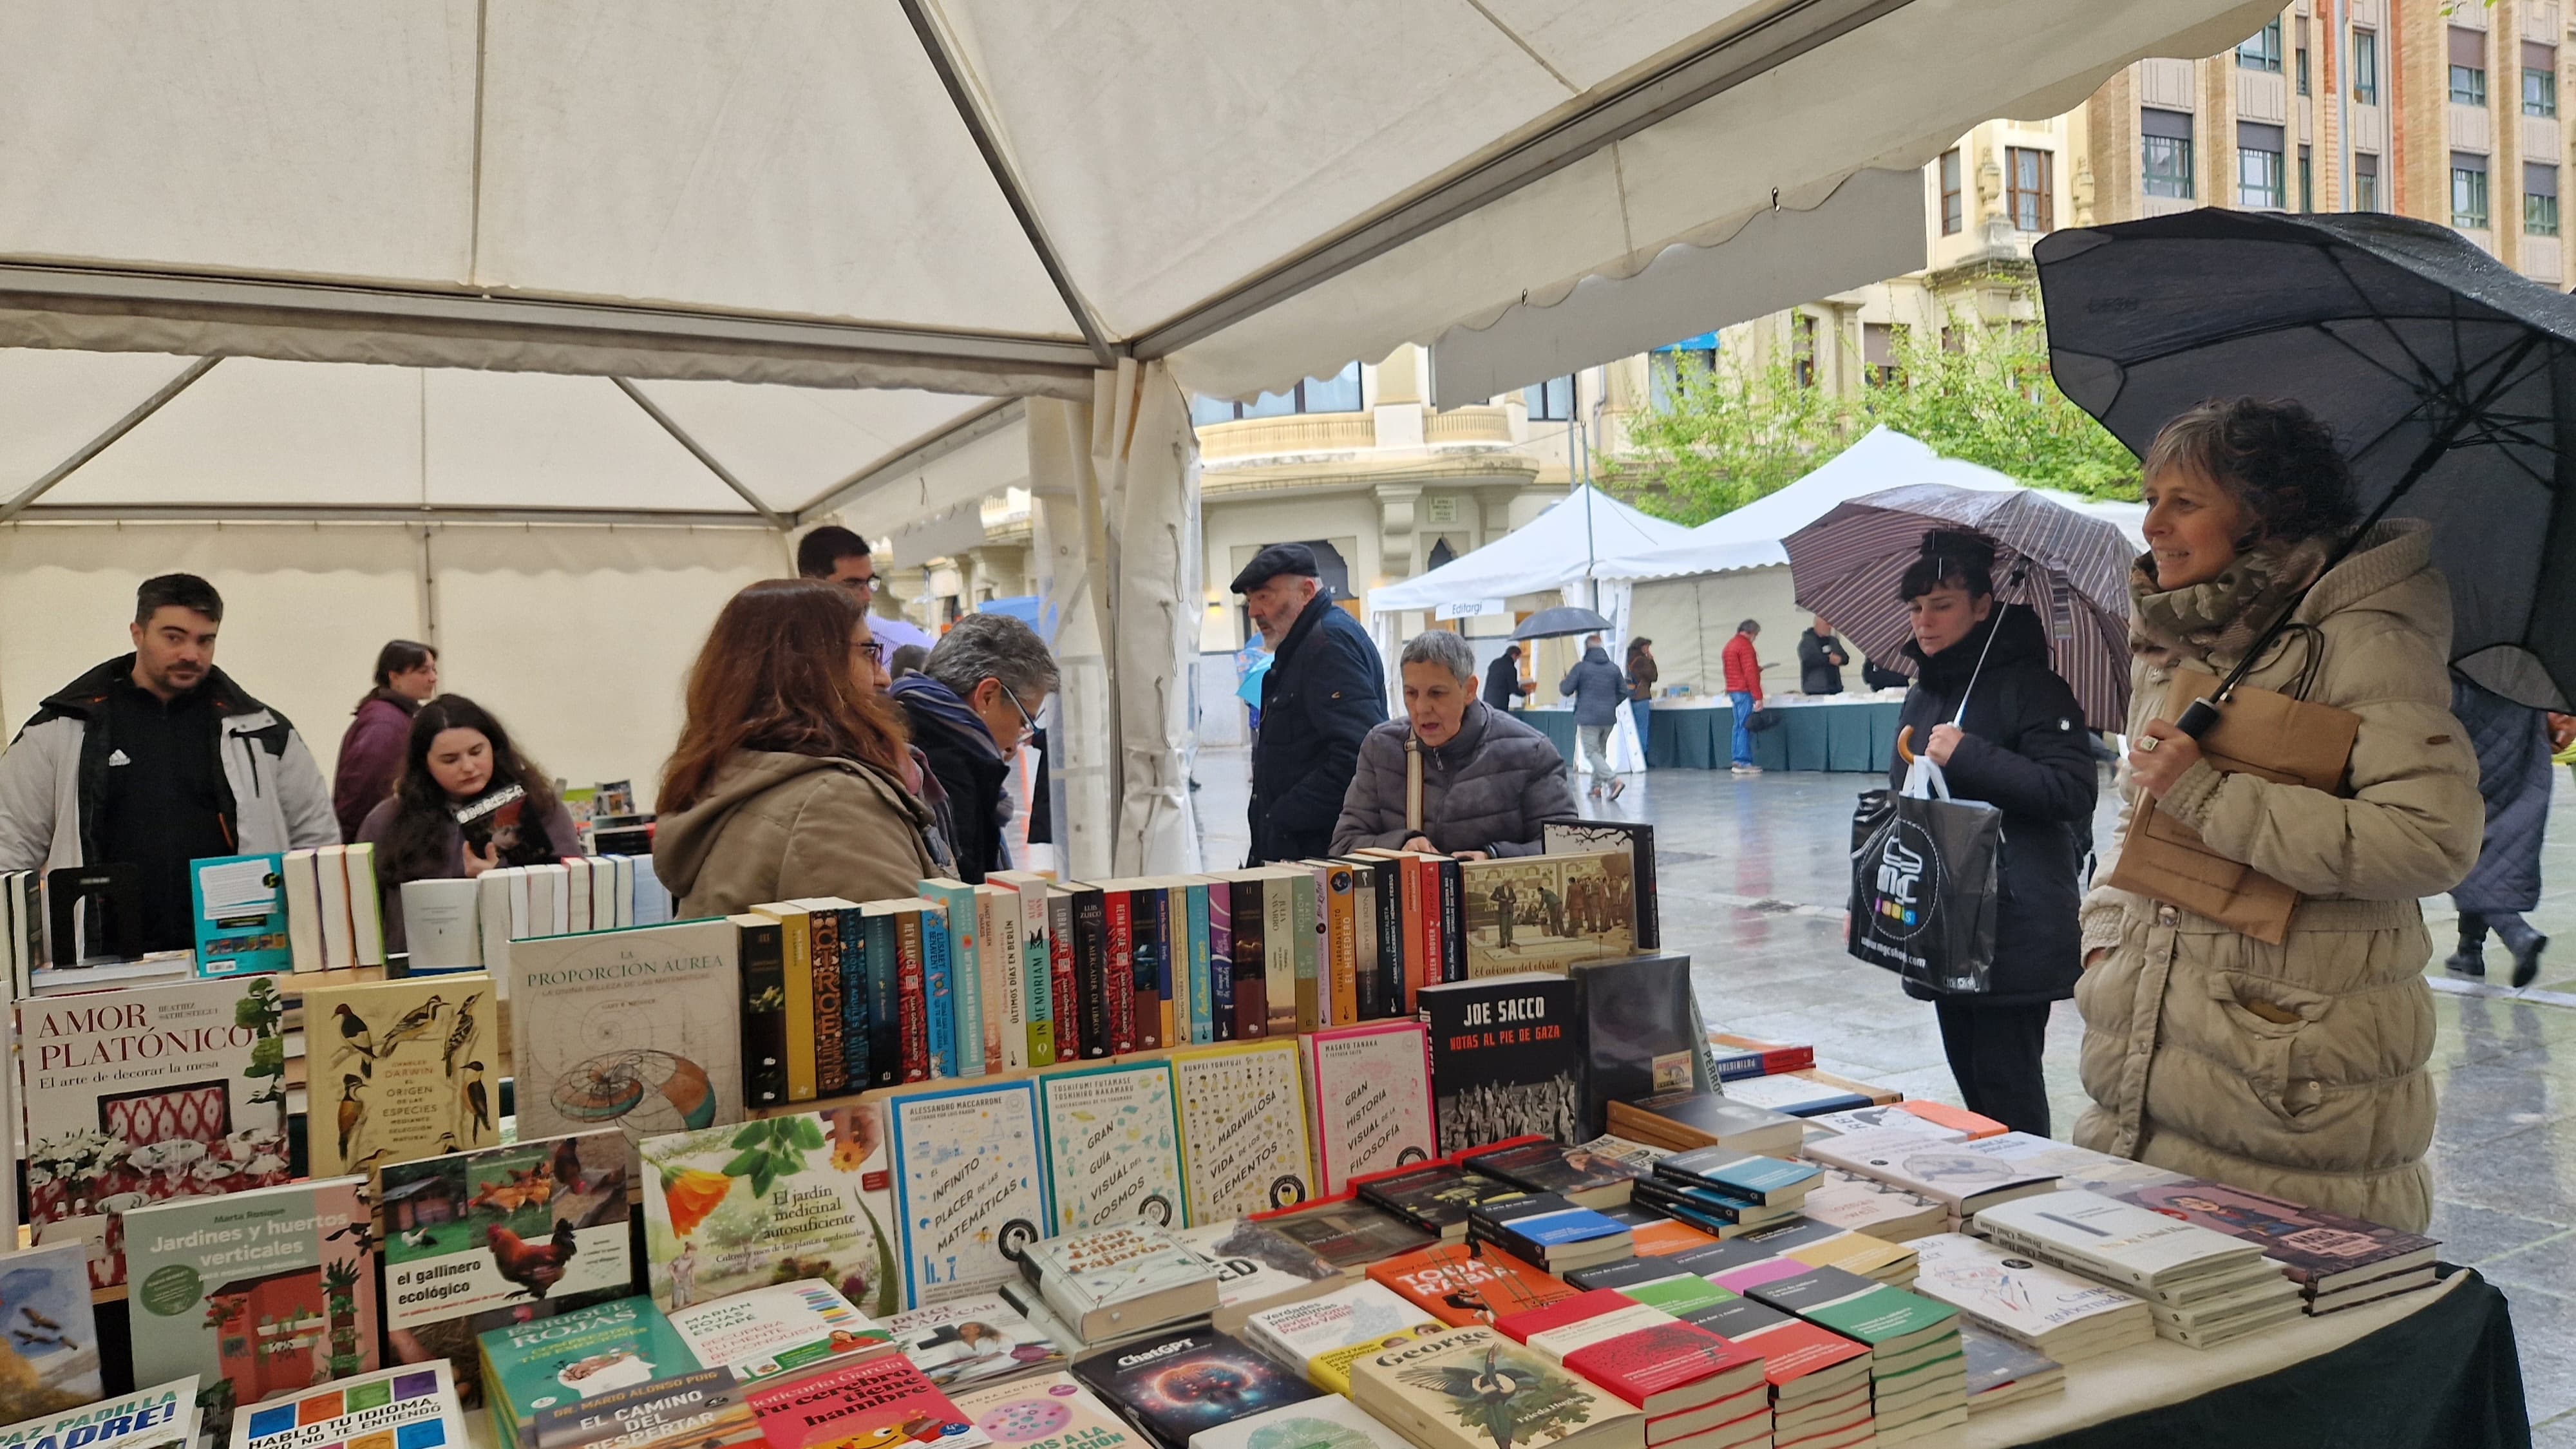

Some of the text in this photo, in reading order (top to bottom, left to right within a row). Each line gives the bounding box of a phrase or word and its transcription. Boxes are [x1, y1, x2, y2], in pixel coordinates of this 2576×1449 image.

[1452, 601, 1482, 616] Editargi
[1056, 908, 1067, 927] LOBA
[1115, 904, 1126, 926] REINA
[903, 923, 915, 938] REY
[1005, 920, 1015, 951] BERLÍN
[620, 950, 634, 960] LA
[1007, 953, 1016, 964] EN
[1343, 916, 1353, 983] EL HEREDERO
[527, 960, 658, 987] PROPORCIÓN
[1007, 966, 1017, 986] DÍAS
[1088, 945, 1099, 990] MERCADER
[1473, 960, 1560, 977] El abismo del olvido
[1032, 956, 1046, 1036] IN MEMORIAM
[1092, 993, 1099, 1004] DE
[37, 1003, 149, 1039] AMOR
[1092, 1006, 1100, 1036] LIBROS
[1463, 996, 1545, 1027] JOE SACCO
[39, 1026, 253, 1072] PLATÓNICO
[1325, 1039, 1379, 1052] MASATO TANAKA
[1450, 1025, 1561, 1052] NOTAS AL PIE DE GAZA
[40, 1061, 220, 1089] El arte de decorar la mesa
[384, 1066, 433, 1079] DARWIN
[1184, 1060, 1242, 1072] BUNPEI YORIFUJI
[386, 1086, 433, 1097] ORIGEN
[1095, 1076, 1132, 1088] FUTAMASE
[1345, 1080, 1368, 1107] GRAN
[383, 1104, 438, 1117] ESPECIES
[909, 1096, 1003, 1116] ALESSANDRO MACCARRONE
[1346, 1088, 1387, 1130] HISTORIA
[1087, 1120, 1115, 1150] GRAN
[1209, 1090, 1276, 1154] LA MARAVILLOSA
[1347, 1106, 1396, 1151] VISUAL DE LA
[1210, 1135, 1261, 1179] VIDA DE LOS
[1350, 1123, 1401, 1174] FILOSOFÍA
[930, 1168, 939, 1178] EL
[1089, 1150, 1112, 1175] GUÍA
[1213, 1141, 1278, 1206] ELEMENTOS
[933, 1158, 980, 1204] INFINITO
[1090, 1157, 1142, 1202] VISUAL DEL
[774, 1184, 833, 1207] El jardín
[934, 1173, 1000, 1229] PLACER DE LAS
[1093, 1175, 1145, 1227] COSMOS
[214, 1208, 286, 1224] Marta Rosique
[774, 1198, 842, 1222] medicinal
[938, 1179, 1018, 1254] MATEMÁTICAS
[150, 1212, 349, 1253] Jardines y huertos
[762, 1213, 856, 1240] autosuficiente
[200, 1239, 305, 1267] verticales
[715, 1229, 866, 1264] Cultivo y usos de las plantas medicinales
[397, 1259, 481, 1286] el gallinero
[1395, 1260, 1486, 1287] TODA
[1411, 1265, 1519, 1297] RABIA
[398, 1280, 470, 1306] ecológico
[2056, 1287, 2113, 1302] Carne
[684, 1302, 753, 1325] MARIAN
[688, 1312, 747, 1332] ROJAS
[891, 1306, 951, 1325] DULCE
[1262, 1302, 1321, 1321] Verdades
[1269, 1303, 1338, 1326] penúltimas
[2044, 1294, 2134, 1323] gobernada
[513, 1311, 638, 1349] ROJAS
[701, 1320, 785, 1348] RECUPERA
[1276, 1314, 1313, 1331] Javier
[1280, 1318, 1323, 1335] Pedro
[709, 1323, 826, 1361] RECONQUISTA
[1117, 1338, 1196, 1367] ChatGPT
[1375, 1330, 1494, 1368] George
[838, 1359, 905, 1383] García
[553, 1371, 719, 1419] DR. MARIO ALONSO PUIG
[754, 1369, 913, 1419] Tu cerebro
[840, 1376, 924, 1403] tiene
[55, 1390, 177, 1434] PADILLA
[579, 1389, 704, 1432] EL CAMINO
[802, 1385, 930, 1428] hambre
[1516, 1393, 1589, 1424] Frieda Hughes
[249, 1397, 439, 1449] HABLO TU IDIOMA,
[301, 1432, 325, 1446] NO
[334, 1426, 353, 1437] TE
[624, 1412, 669, 1433] DEL
[1064, 1434, 1078, 1446] A
[1078, 1425, 1108, 1440] LA
